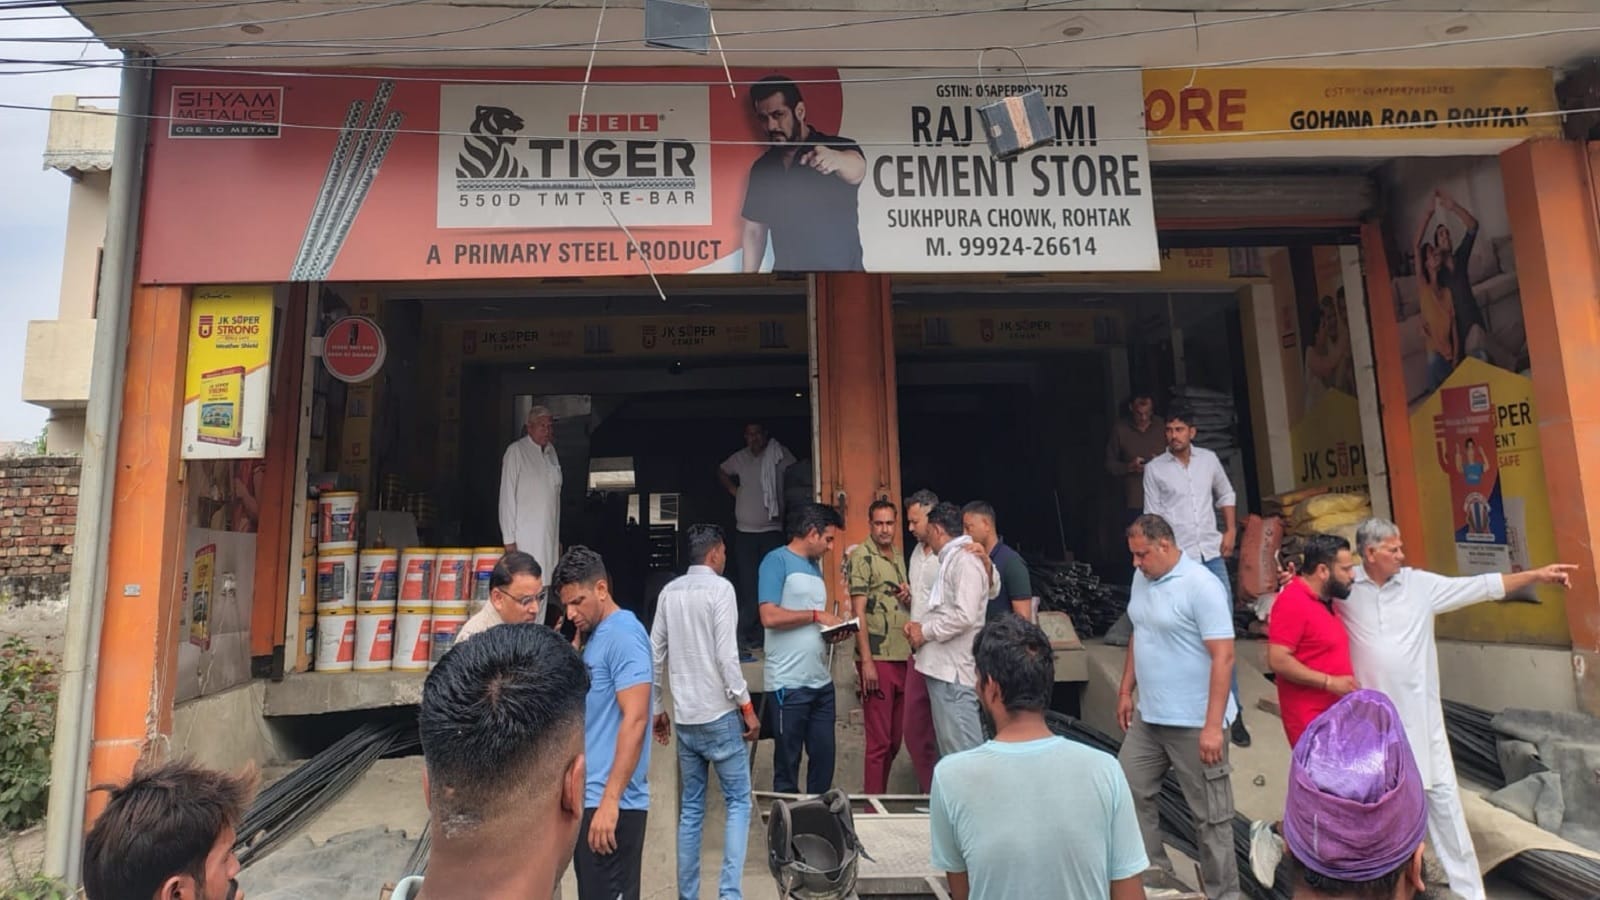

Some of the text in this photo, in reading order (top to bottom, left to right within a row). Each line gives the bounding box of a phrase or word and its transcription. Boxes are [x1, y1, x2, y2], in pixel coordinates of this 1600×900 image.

[936, 84, 972, 97] GSTIN:
[178, 92, 275, 107] SHYAM
[177, 109, 276, 121] METALICS
[1145, 88, 1247, 132] ORE
[1290, 106, 1529, 130] GOHANA ROAD ROHTAK
[529, 138, 696, 178] TIGER
[872, 154, 1142, 197] CEMENT STORE
[460, 190, 695, 207] 550D TMT RE-BAR
[887, 208, 1131, 230] SUKHPURA CHOWK, ROHTAK
[426, 240, 722, 265] A PRIMARY STEEL PRODUCT
[927, 236, 1097, 257] M. 99924-26614
[218, 315, 260, 325] JK SUPER
[217, 325, 260, 334] STRONG
[662, 326, 676, 338] JK
[481, 332, 497, 344] JK
[1495, 432, 1516, 448] ENT
[1301, 442, 1368, 482] JK SUP
[1499, 455, 1520, 467] SAFE
